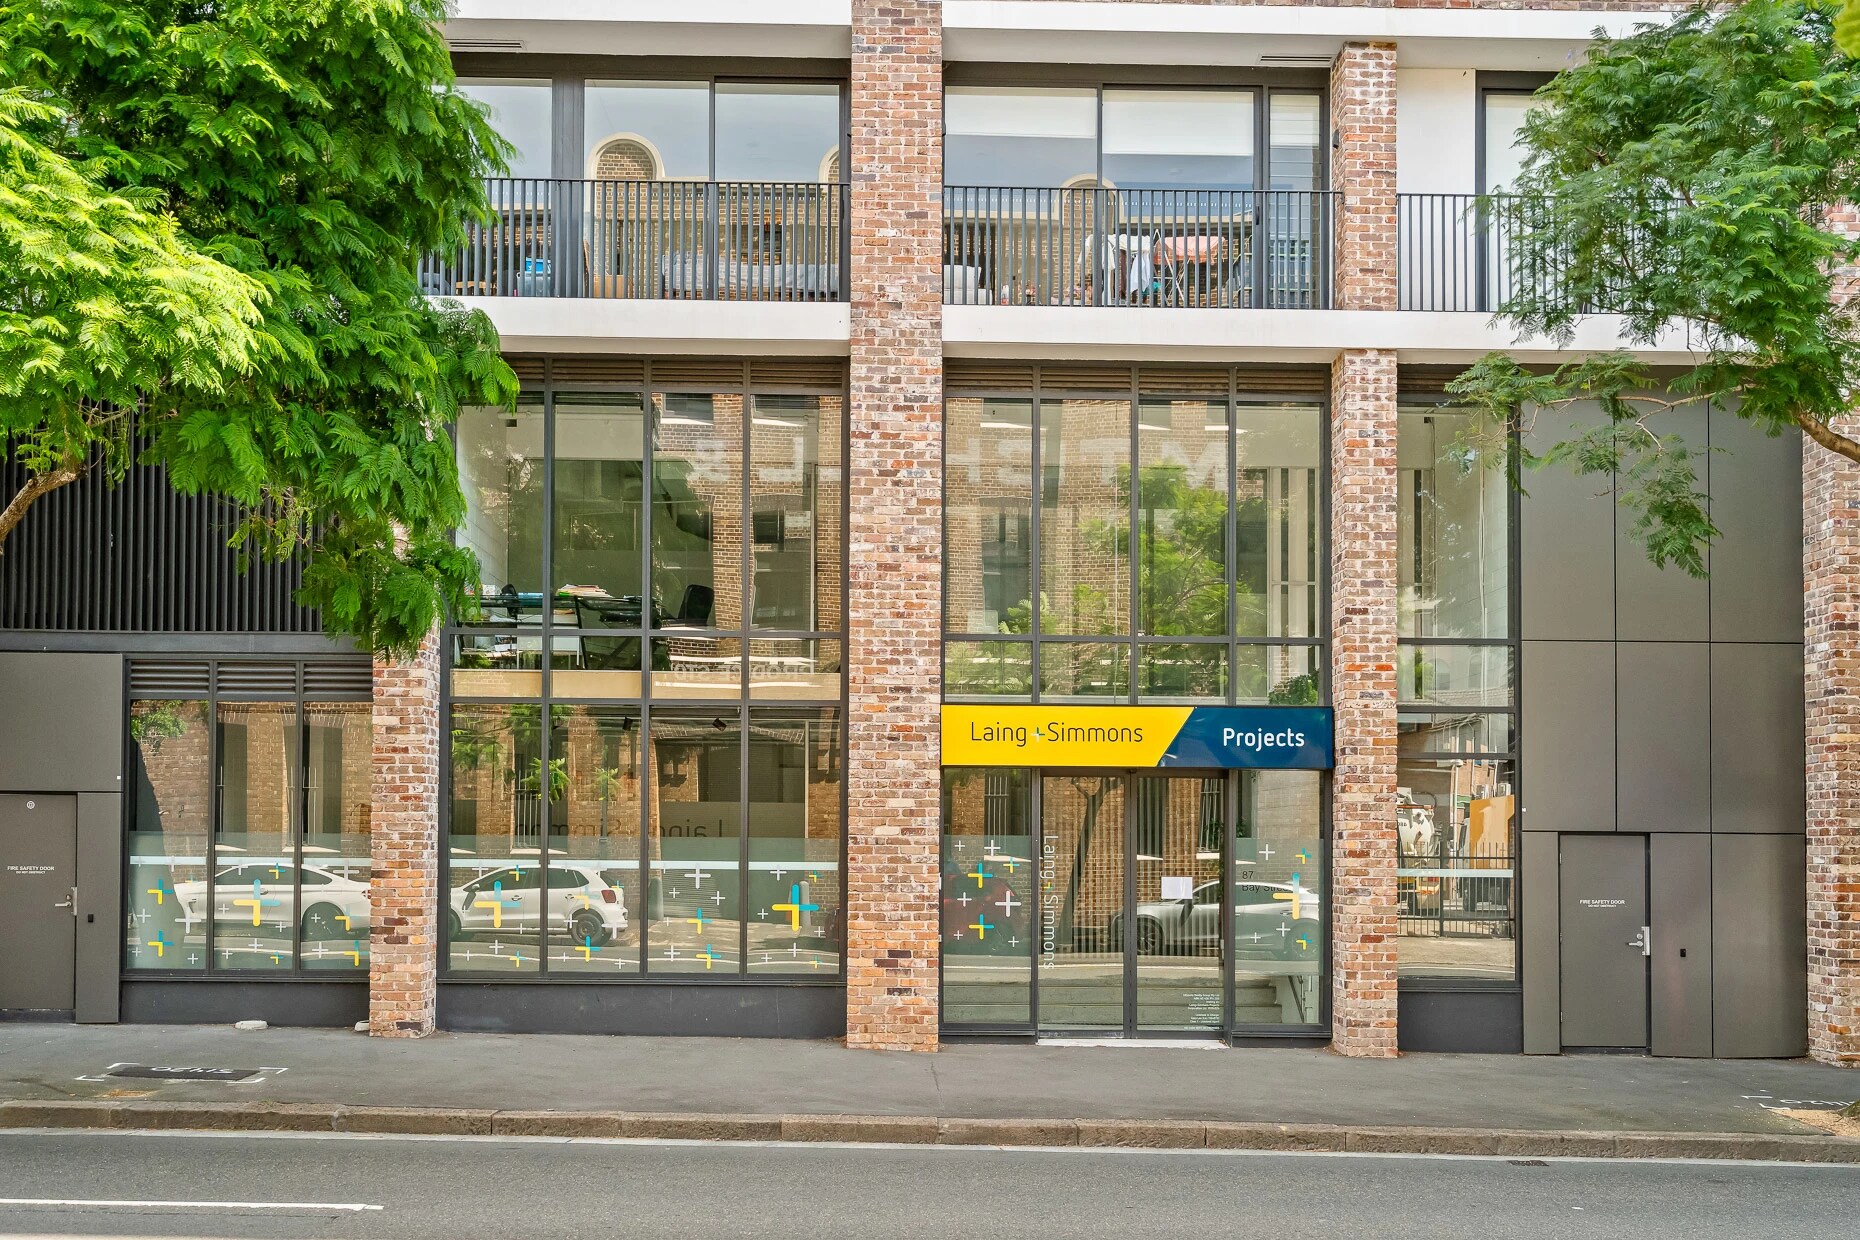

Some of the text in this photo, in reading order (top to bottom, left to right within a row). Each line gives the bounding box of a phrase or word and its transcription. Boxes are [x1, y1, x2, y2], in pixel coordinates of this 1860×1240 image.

[970, 722, 1027, 747] Laing
[1047, 722, 1143, 743] Simmons
[1223, 727, 1305, 752] Projects
[1040, 835, 1059, 880] Laing
[1242, 870, 1255, 880] 87
[1241, 882, 1261, 894] Bay
[1043, 895, 1059, 970] Simmons
